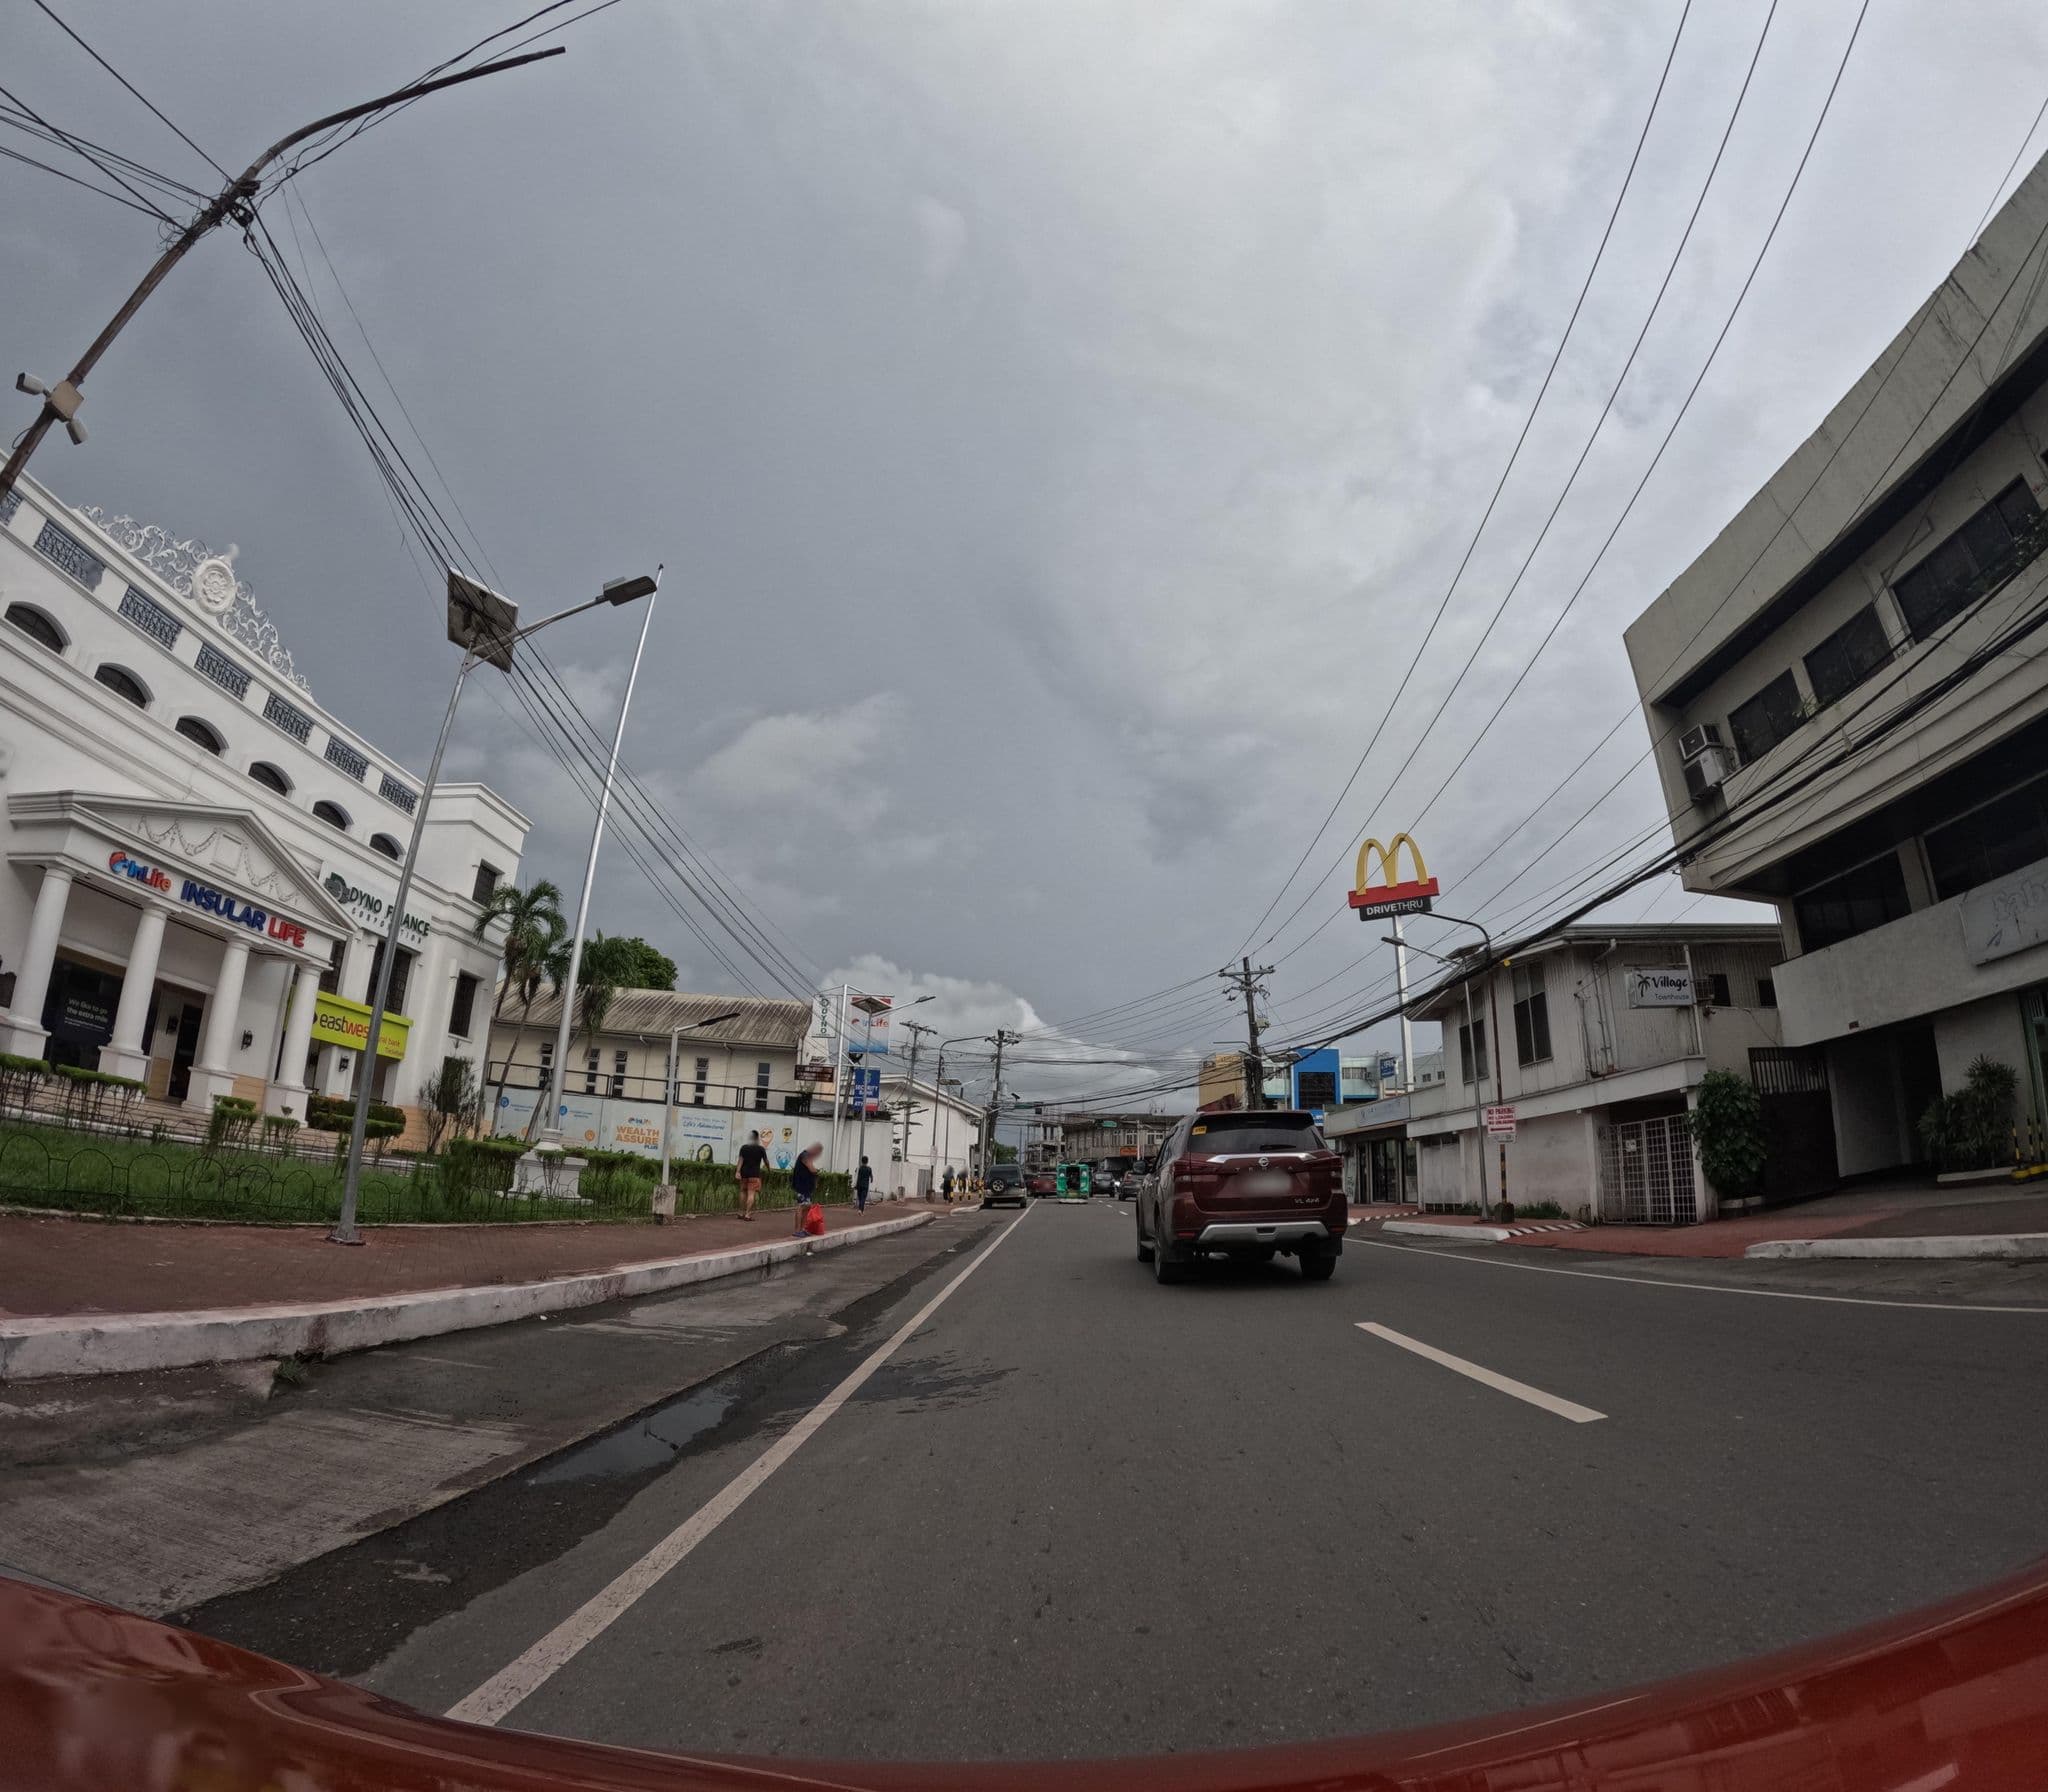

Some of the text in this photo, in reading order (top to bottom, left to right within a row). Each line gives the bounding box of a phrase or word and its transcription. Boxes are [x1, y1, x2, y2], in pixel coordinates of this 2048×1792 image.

[180, 879, 307, 948] INSULAR LIFE
[349, 886, 430, 937] DYNO FANCE
[1652, 975, 1689, 992] Village
[319, 1013, 369, 1039] eastwes
[855, 1084, 879, 1092] SECRITY
[615, 1134, 659, 1145] ASSURE
[616, 1125, 660, 1137] WEALTH
